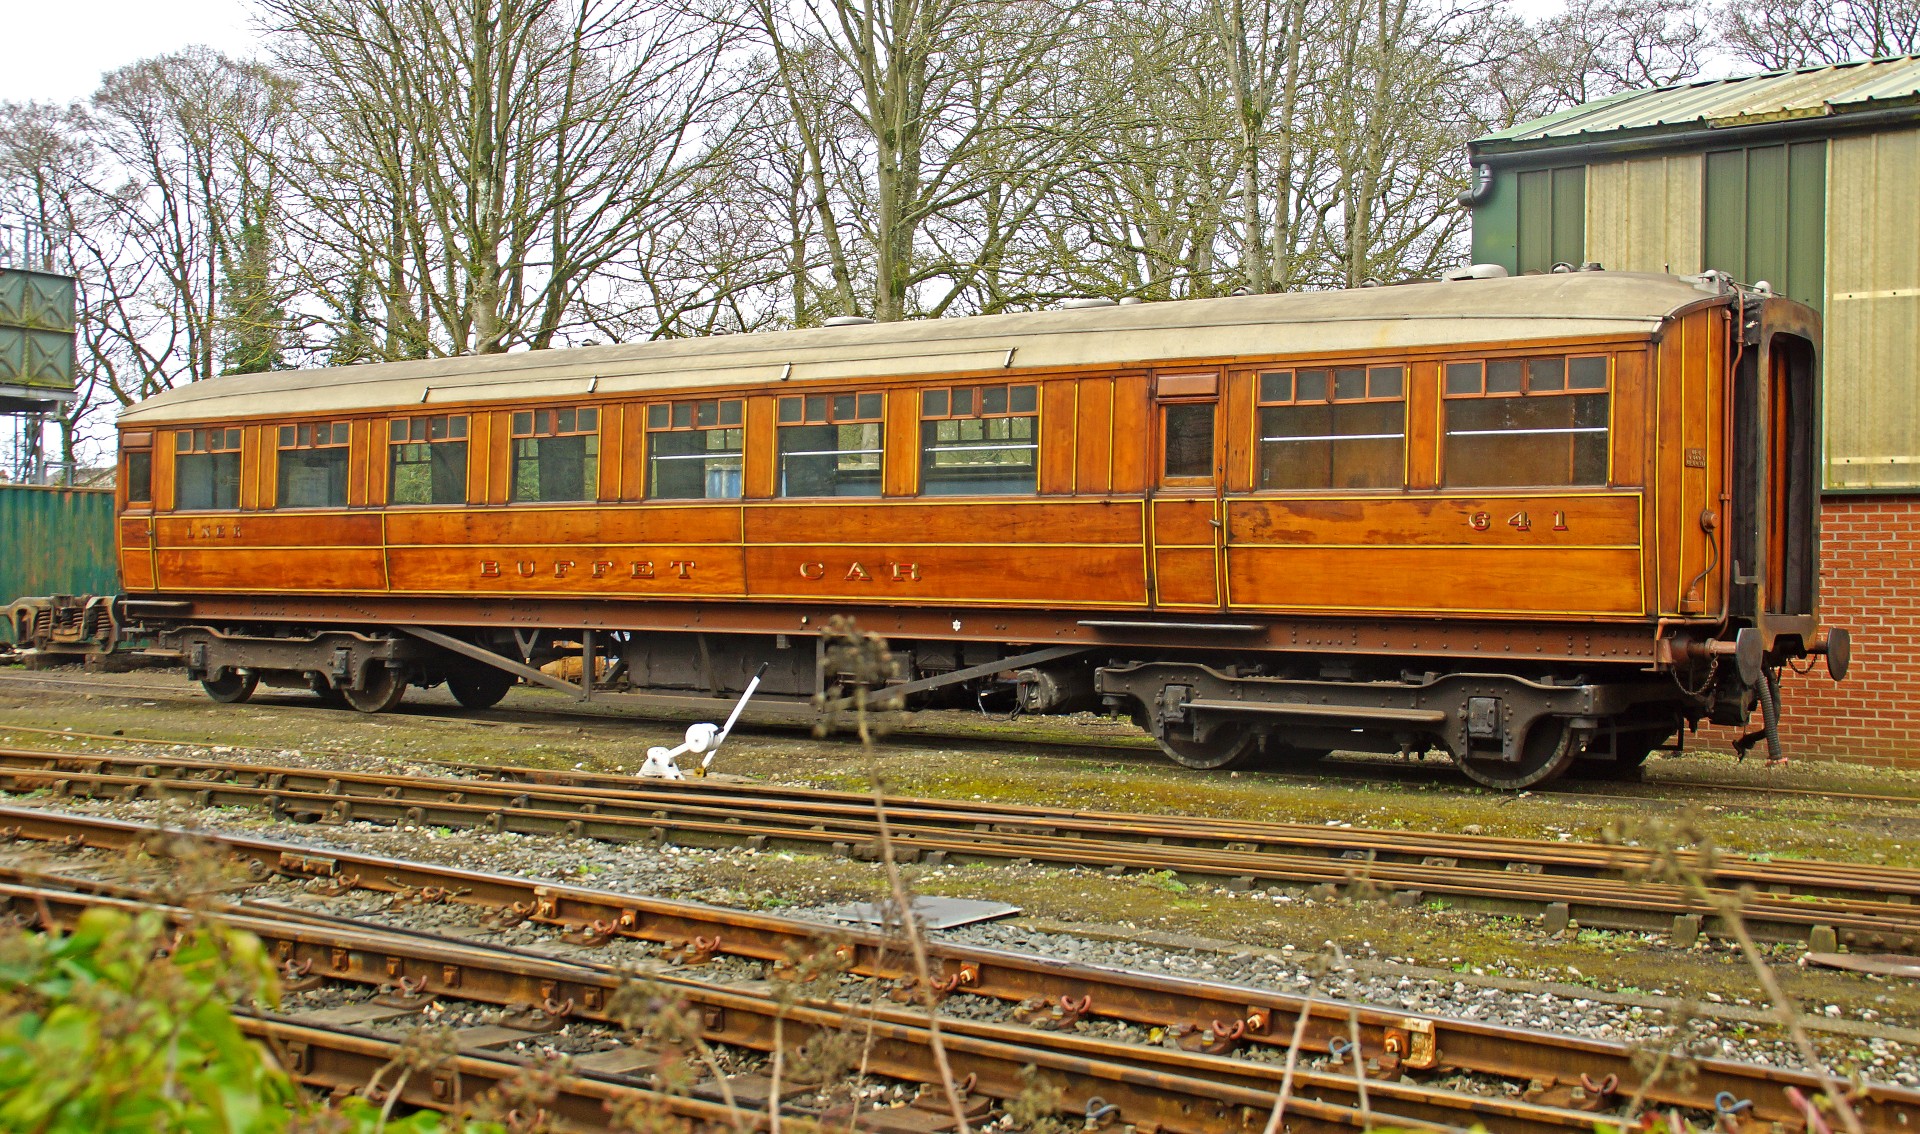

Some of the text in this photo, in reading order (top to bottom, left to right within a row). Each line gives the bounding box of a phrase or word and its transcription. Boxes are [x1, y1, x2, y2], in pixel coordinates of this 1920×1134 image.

[1469, 511, 1568, 531] 641
[480, 560, 922, 582] BUFFET CAR
